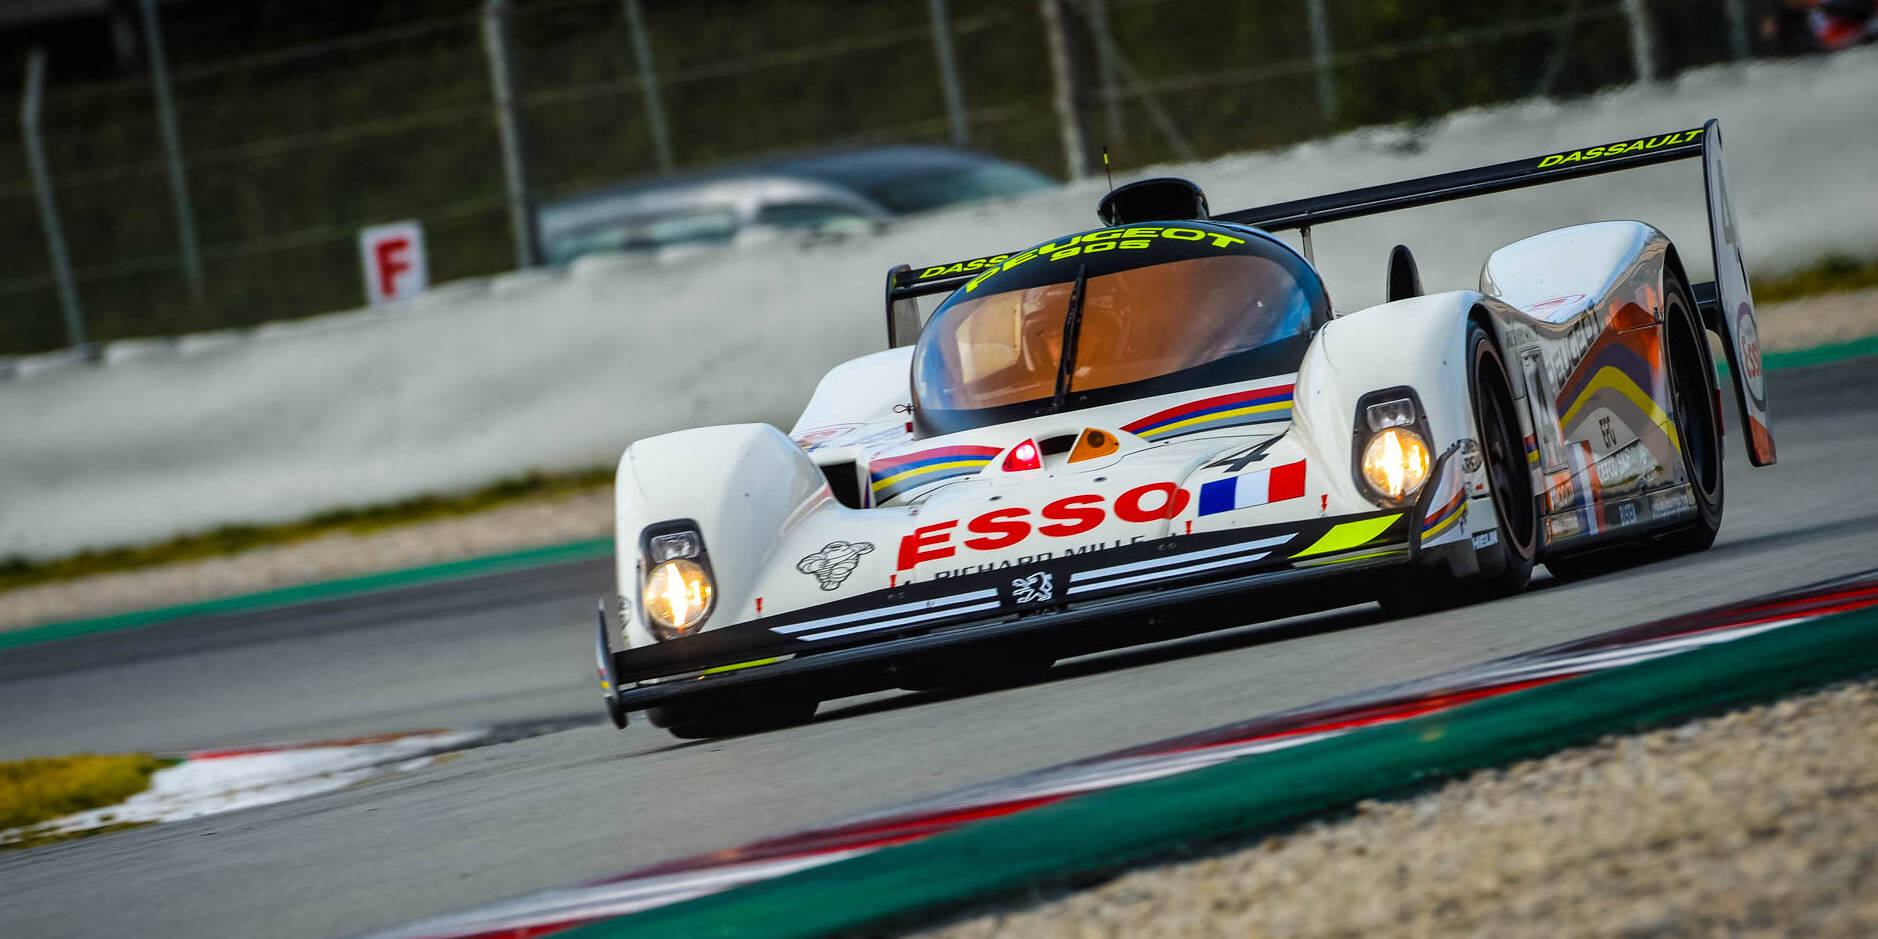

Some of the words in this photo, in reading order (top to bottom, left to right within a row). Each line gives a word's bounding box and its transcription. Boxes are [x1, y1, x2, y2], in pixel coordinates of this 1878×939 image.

[1537, 128, 1704, 168] DASSAULT
[373, 236, 411, 297] F
[966, 227, 1246, 293] PEUGEOT
[1050, 239, 1151, 261] 905
[897, 482, 1191, 571] ESSO
